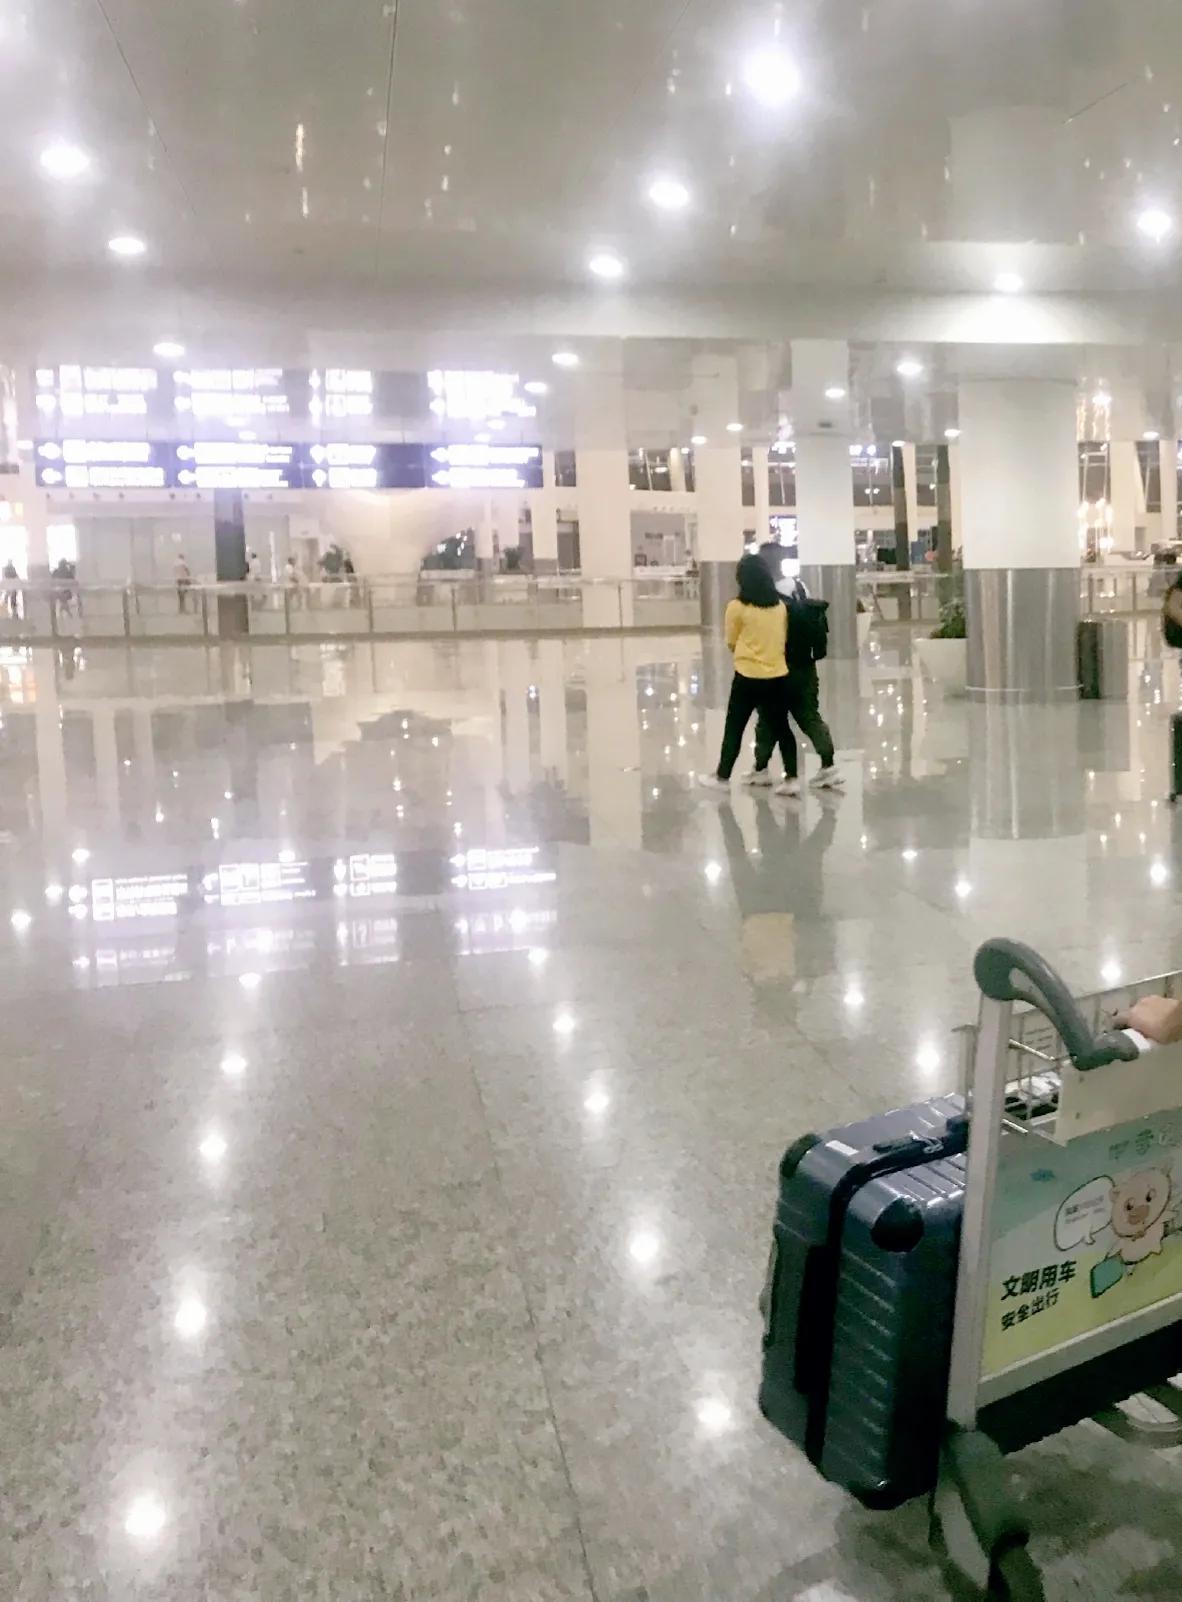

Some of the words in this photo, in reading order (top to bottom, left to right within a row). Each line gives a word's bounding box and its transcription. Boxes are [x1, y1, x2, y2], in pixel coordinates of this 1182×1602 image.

[1001, 1260, 1077, 1301] 文明用车
[1001, 1287, 1060, 1331] 安全出行
